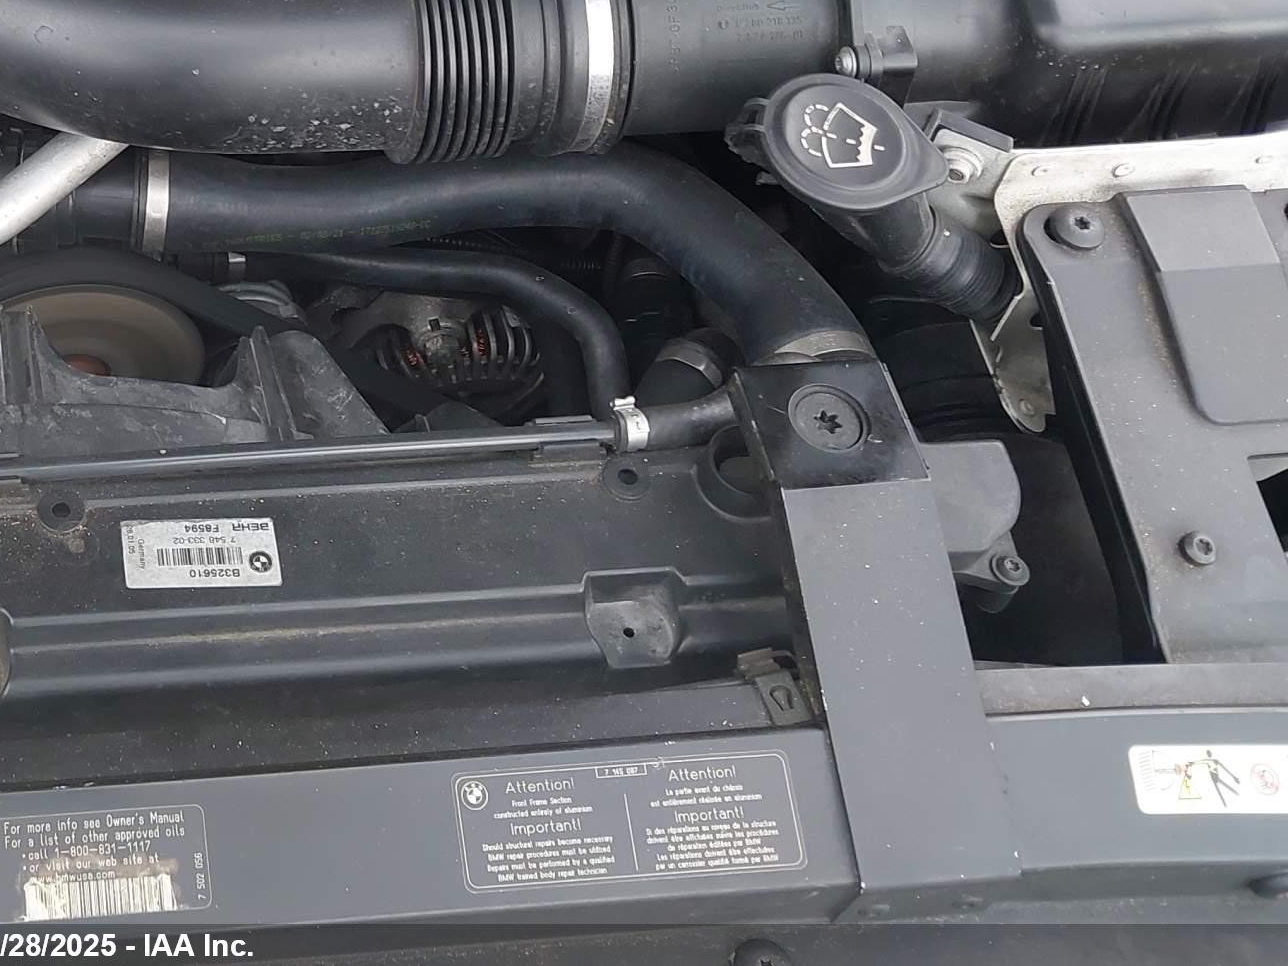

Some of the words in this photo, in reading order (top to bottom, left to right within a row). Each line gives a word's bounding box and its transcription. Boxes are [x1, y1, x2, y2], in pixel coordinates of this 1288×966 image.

[184, 523, 220, 533] F8594
[232, 522, 269, 532] BEHR
[137, 538, 145, 570] Germany
[190, 568, 240, 578] B325610
[668, 765, 736, 782] Attention!
[506, 777, 575, 794] Attention!
[3, 821, 21, 835] For
[28, 822, 52, 834] more
[84, 819, 101, 829] see
[106, 814, 145, 828] Owner's
[149, 810, 185, 825] Manual
[675, 805, 744, 824] Important!
[510, 818, 582, 837] Important!
[4, 836, 21, 850] For
[28, 838, 34, 847] a
[40, 833, 59, 846] list
[64, 832, 76, 844] of
[82, 830, 109, 843] other
[115, 827, 160, 841] approved
[165, 825, 185, 837] oils
[54, 840, 151, 859] 1-800-831-1117
[46, 857, 70, 871] visit
[76, 860, 92, 870] our
[98, 856, 117, 867] web
[123, 853, 143, 865] site
[149, 853, 160, 864] at
[196, 873, 206, 890] 502
